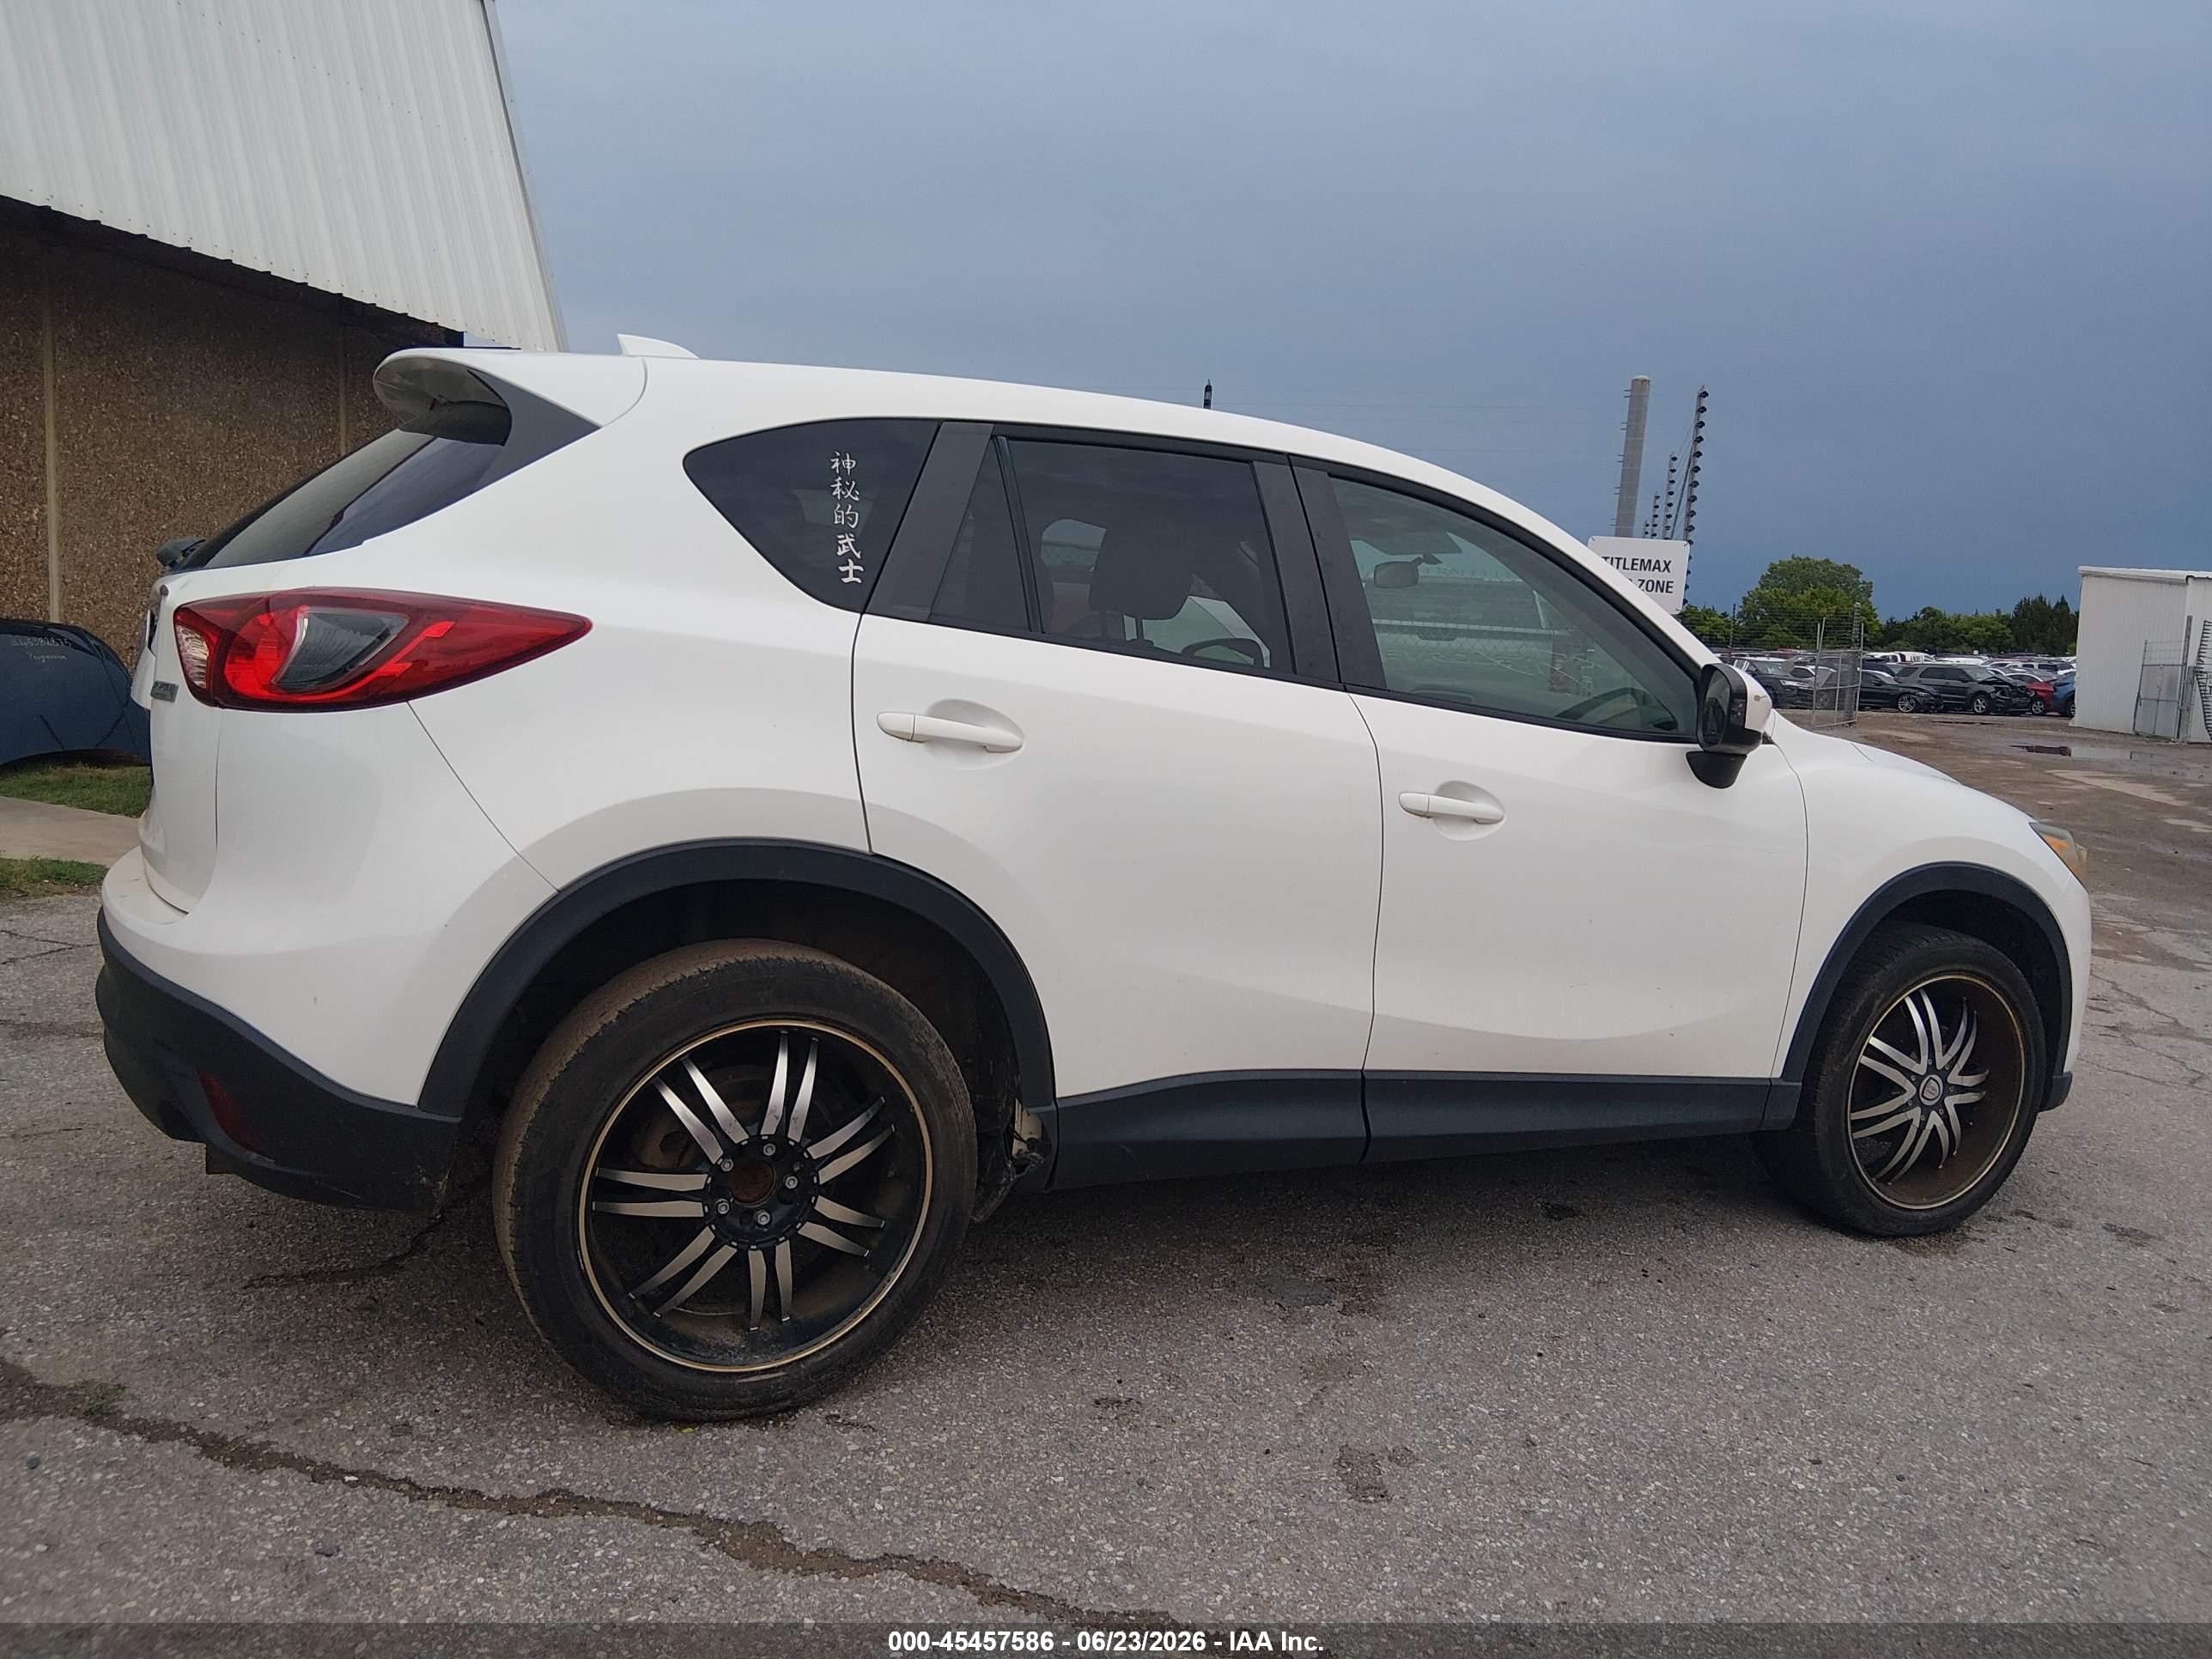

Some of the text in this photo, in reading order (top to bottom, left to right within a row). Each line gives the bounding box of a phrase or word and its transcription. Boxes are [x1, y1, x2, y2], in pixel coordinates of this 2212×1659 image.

[830, 451, 865, 584] 神秘的武士
[1601, 556, 1672, 574] TITLEMAX
[1638, 579, 1674, 594] ZONE
